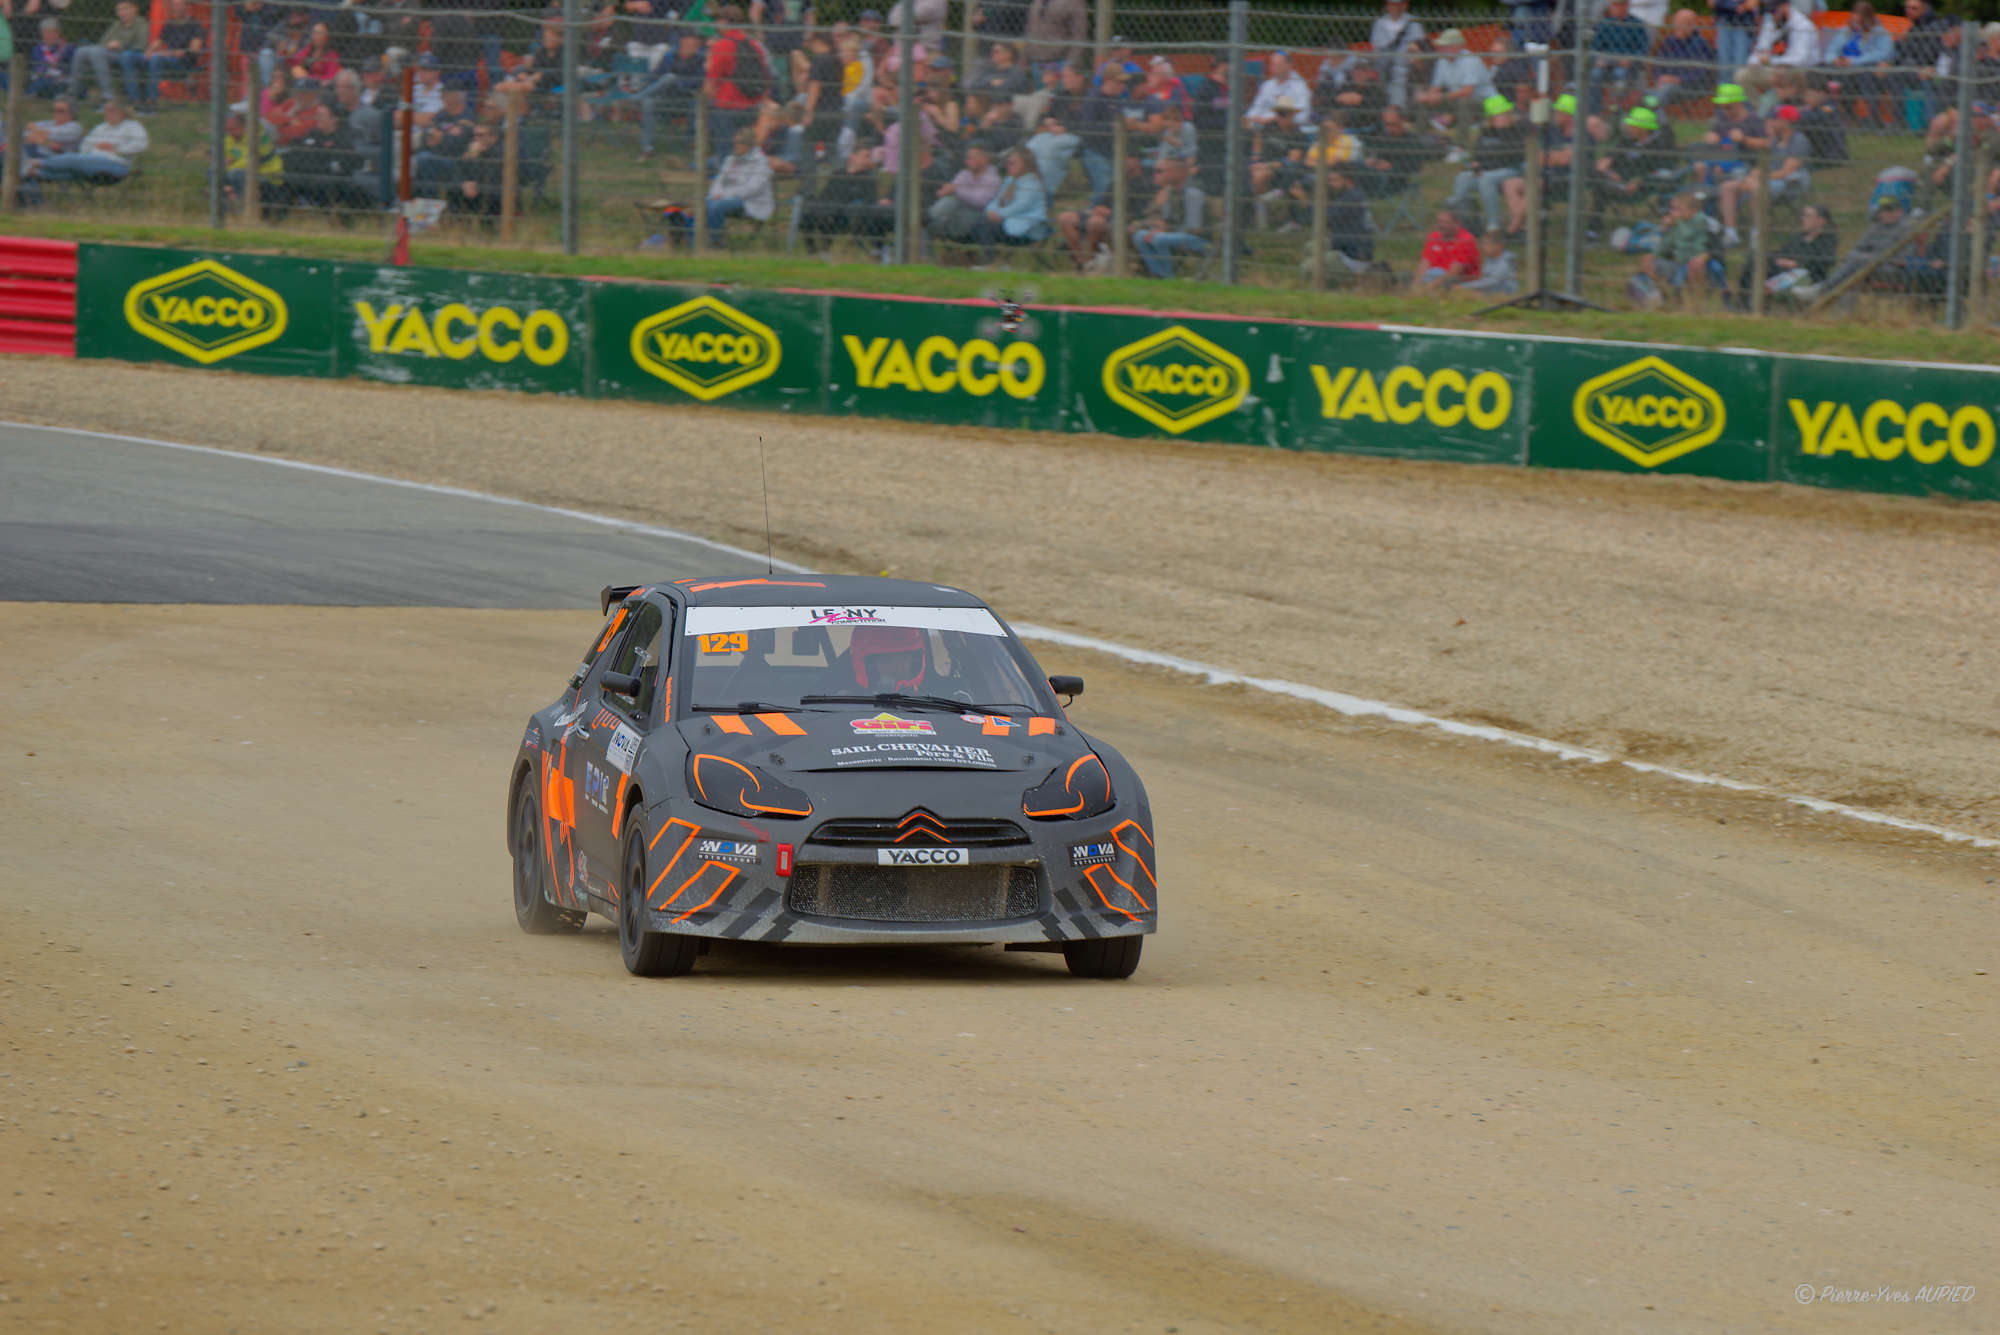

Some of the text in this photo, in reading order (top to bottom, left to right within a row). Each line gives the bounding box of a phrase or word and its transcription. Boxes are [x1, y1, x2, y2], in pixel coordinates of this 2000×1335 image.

[151, 295, 264, 329] YACCO
[355, 301, 569, 366] YACCO
[654, 331, 760, 366] YACCO
[843, 335, 1045, 399] YACCO
[1126, 362, 1229, 398] YACCO
[1310, 365, 1512, 430] YACCO
[1599, 395, 1703, 430] YACCO
[1789, 399, 1996, 467] YACCO
[697, 633, 748, 653] 129
[831, 743, 992, 758] SARL CHEVALIER
[700, 840, 757, 856] NOVA
[887, 849, 961, 864] YACCO
[1073, 843, 1115, 857] NOVA
